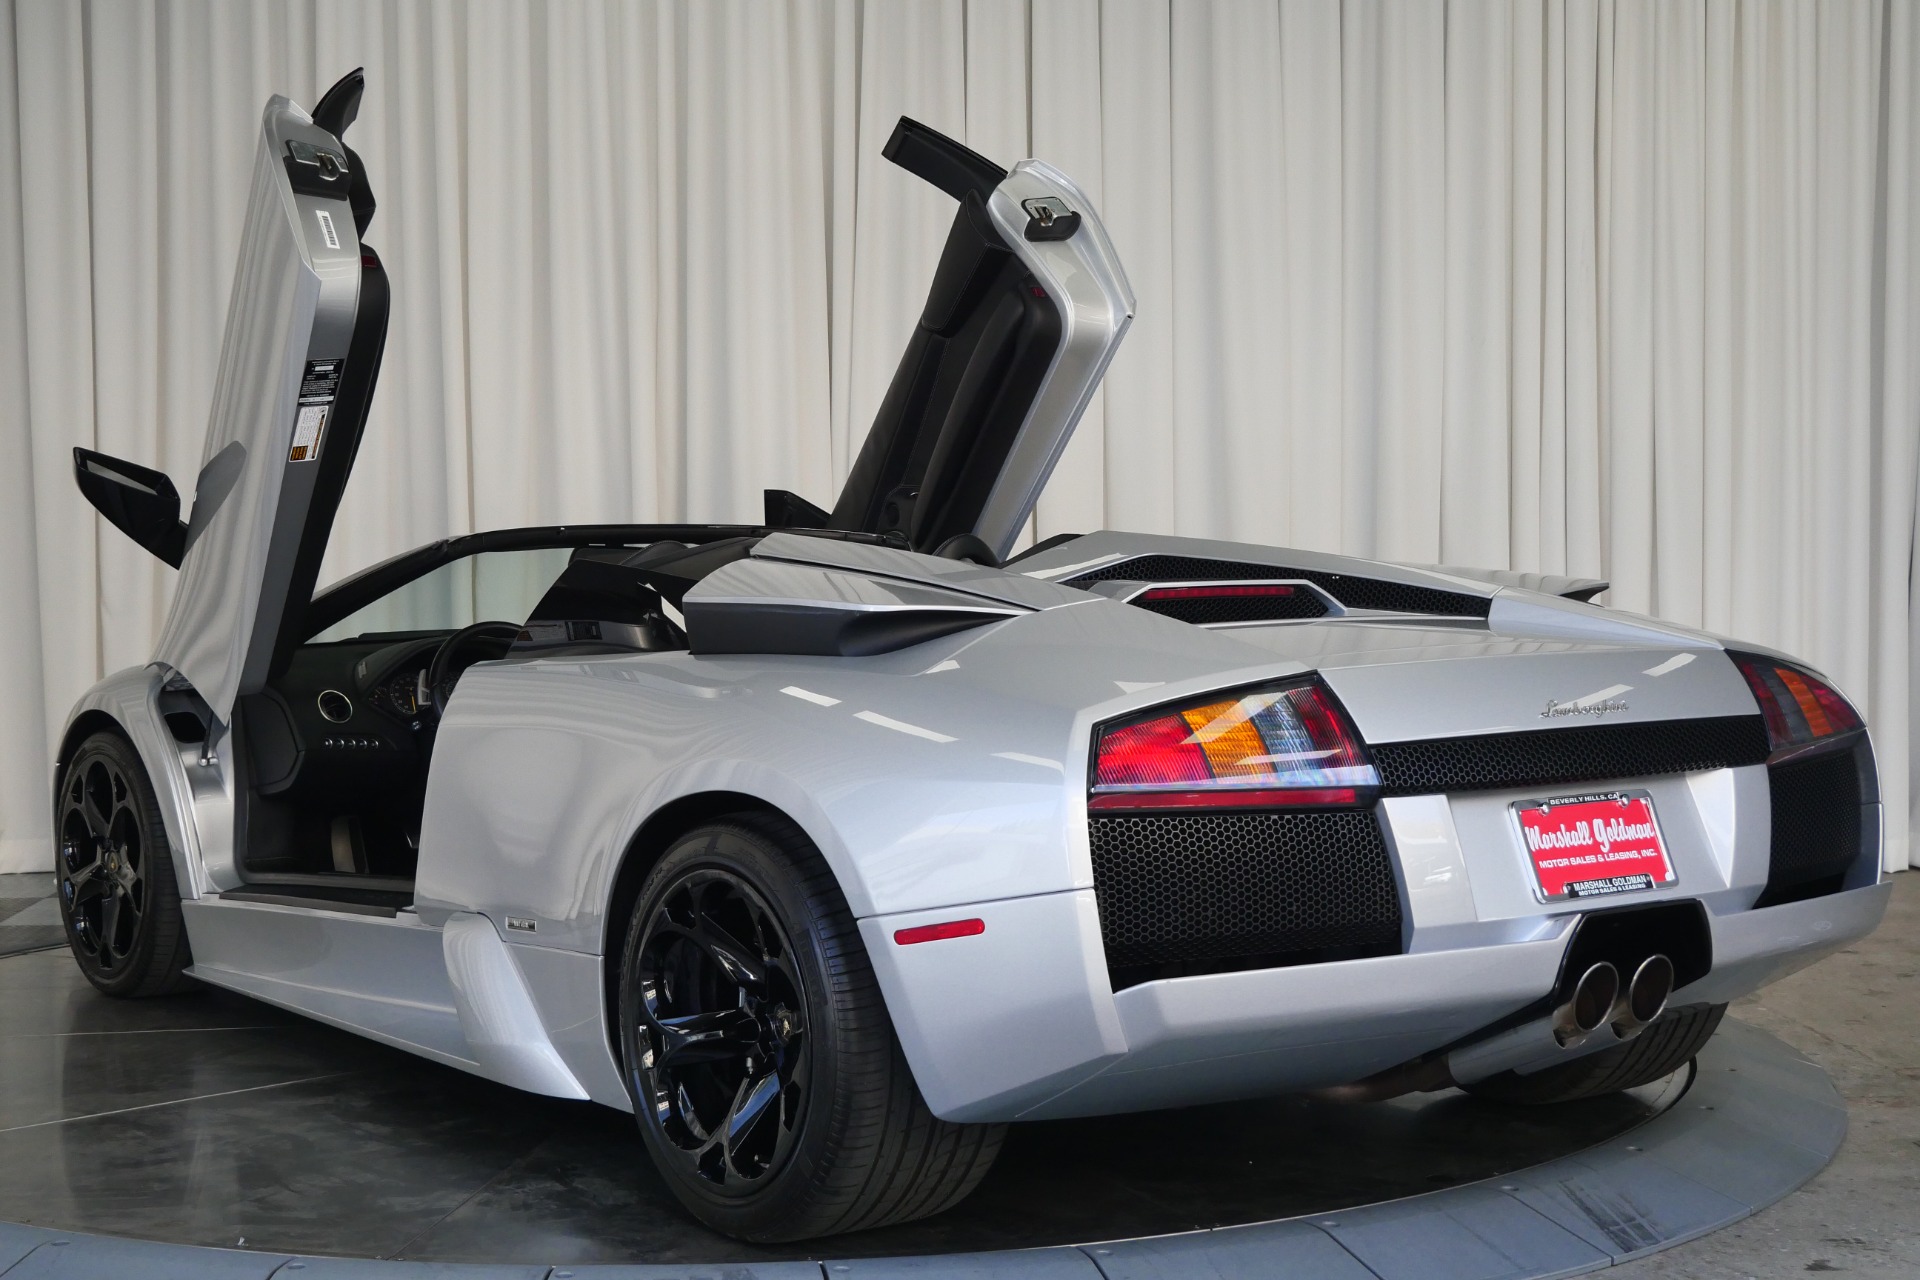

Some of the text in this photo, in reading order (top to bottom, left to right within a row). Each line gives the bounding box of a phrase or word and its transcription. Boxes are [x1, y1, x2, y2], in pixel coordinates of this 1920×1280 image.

[1550, 796, 1584, 805] BEVERLY
[1525, 818, 1654, 852] Marshall Goldman
[1539, 848, 1657, 868] MOTOR SALES & LEASING, INC.
[1573, 875, 1646, 891] MARSHALL GOLDMAN
[1600, 886, 1617, 894] SALES
